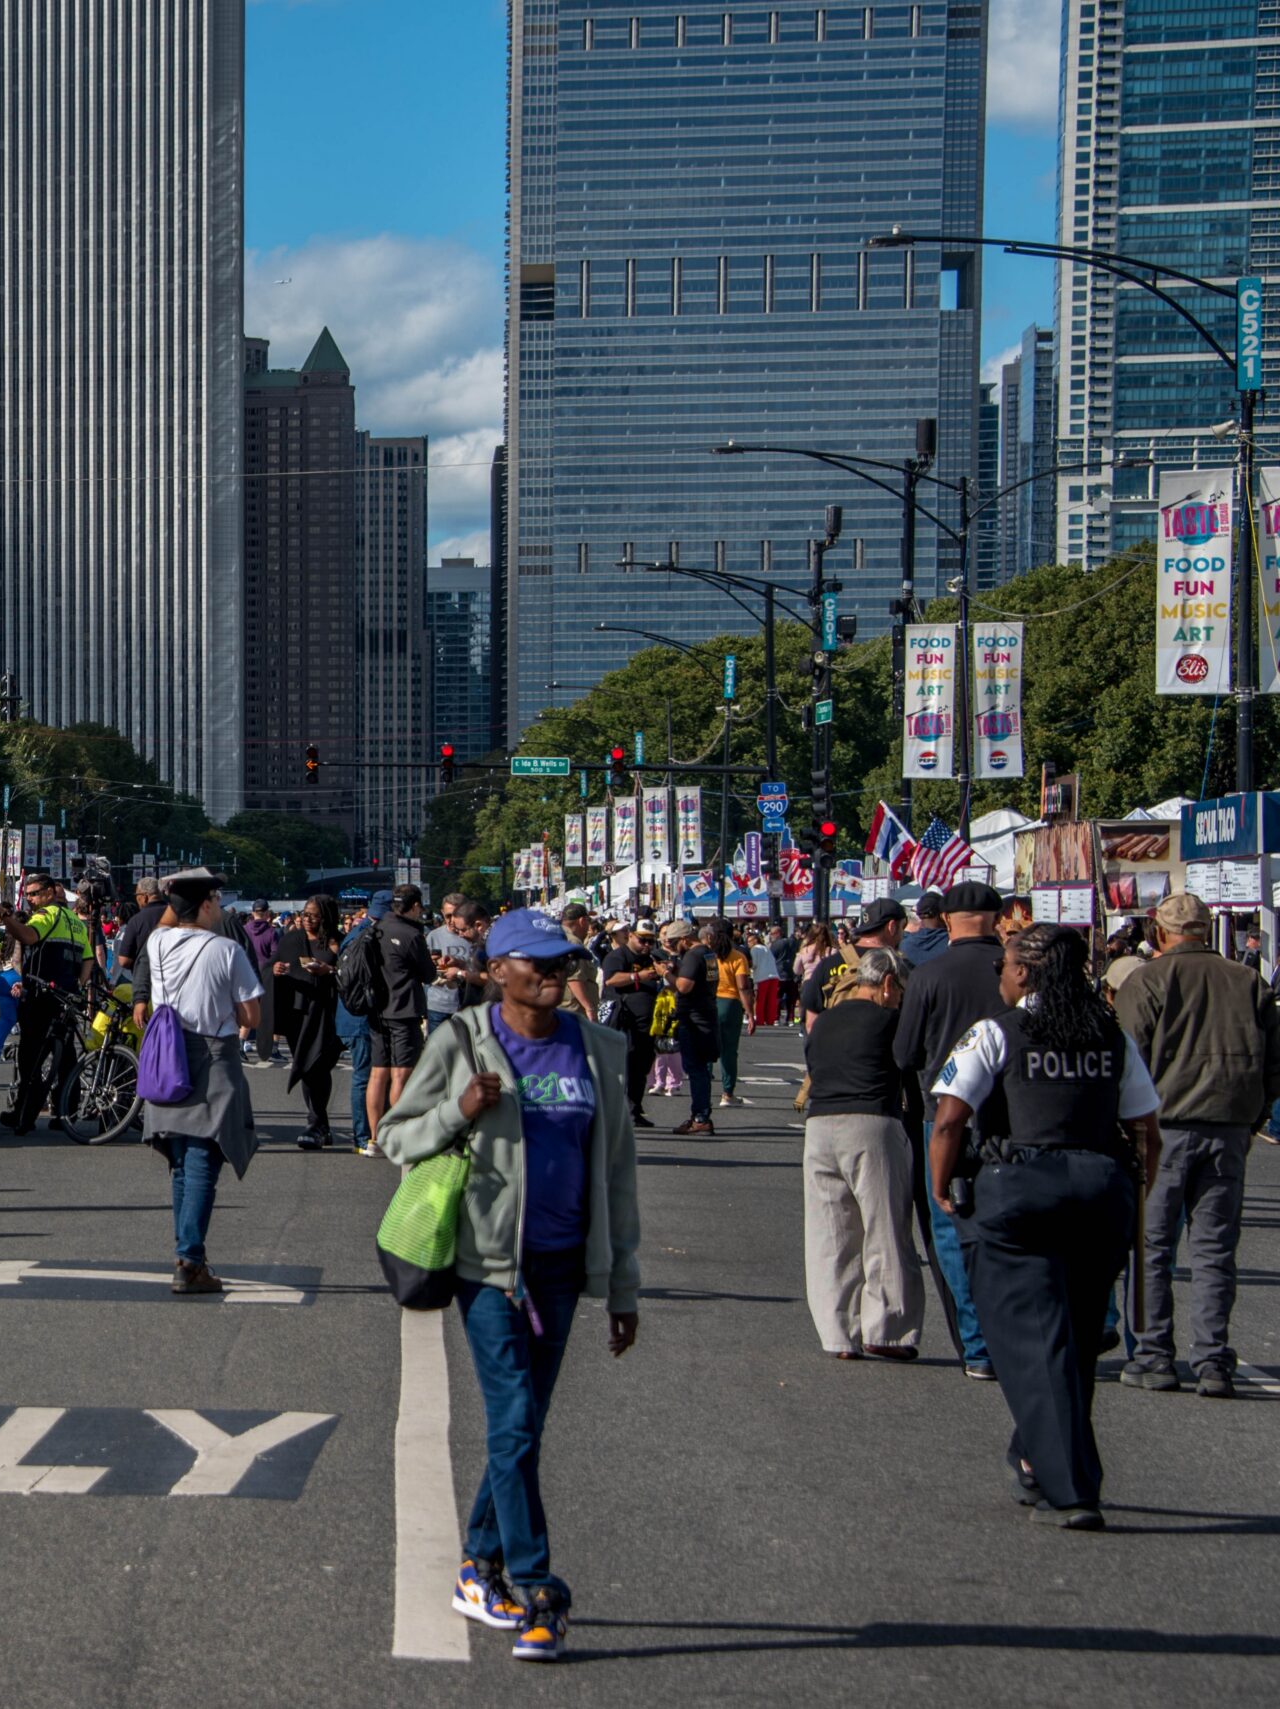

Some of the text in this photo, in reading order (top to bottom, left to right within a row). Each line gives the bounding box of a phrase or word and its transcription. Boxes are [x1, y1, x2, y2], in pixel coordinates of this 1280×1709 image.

[1239, 289, 1259, 379] C521
[1161, 504, 1218, 537] TASTE
[1165, 557, 1225, 573] FOOD
[1174, 580, 1214, 596] FUN
[1161, 603, 1227, 619] MUSIC
[825, 598, 835, 644] C501
[1173, 627, 1214, 641] ART
[910, 638, 951, 648] FOOD
[977, 637, 1018, 648] FOOD
[917, 653, 944, 664] FUN
[984, 653, 1010, 663] FUN
[725, 660, 734, 693] C441
[908, 669, 952, 680] MUSIC
[976, 668, 1018, 679] MUSIC
[916, 685, 944, 696] ART
[984, 685, 1010, 695] ART
[906, 714, 945, 736] TASTE
[975, 714, 1013, 736] TASTE
[763, 802, 783, 812] 290
[1196, 807, 1236, 846] SEOUL TACO
[1027, 1051, 1112, 1079] POLICE
